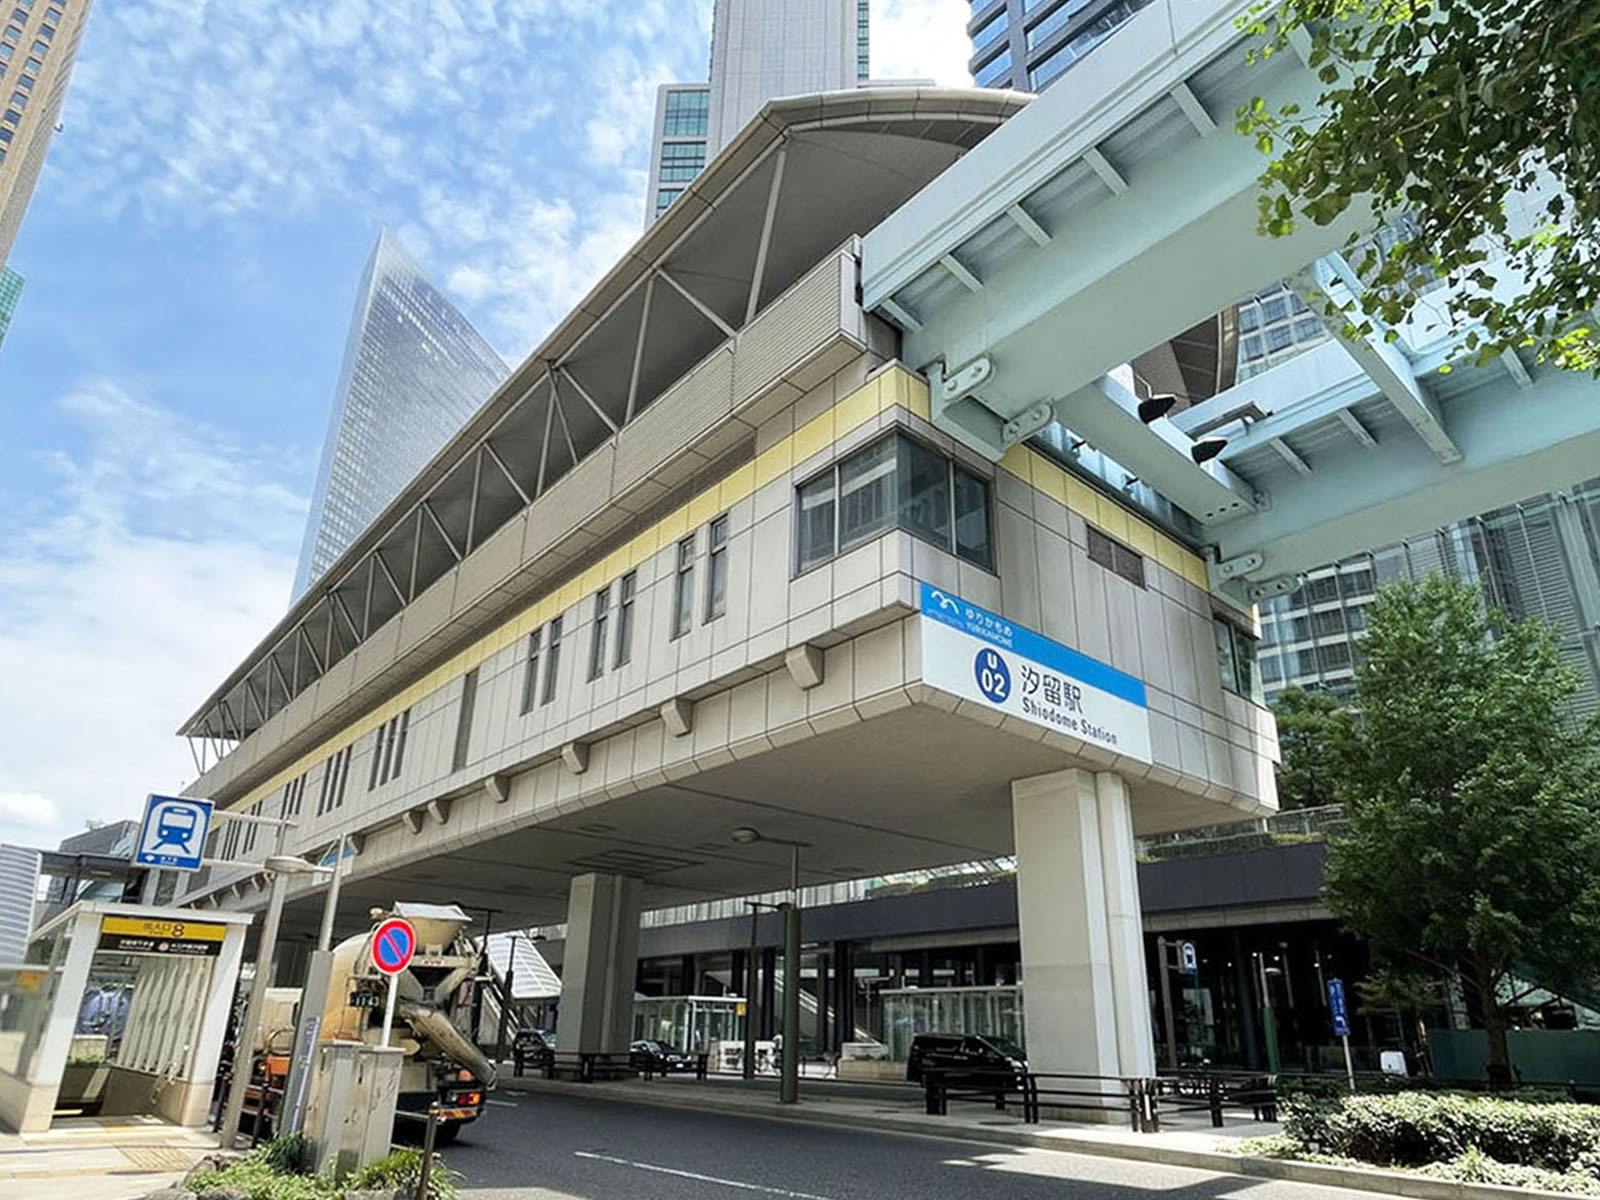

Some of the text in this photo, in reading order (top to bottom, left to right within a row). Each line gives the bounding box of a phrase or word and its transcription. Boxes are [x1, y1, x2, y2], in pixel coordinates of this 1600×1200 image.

[965, 607, 1013, 637] ゆりかもめ
[987, 652, 998, 669] U
[981, 668, 1006, 698] 02
[1020, 664, 1083, 715] 汐留駅
[1022, 696, 1118, 745] Shiodome Station
[171, 923, 185, 937] 8
